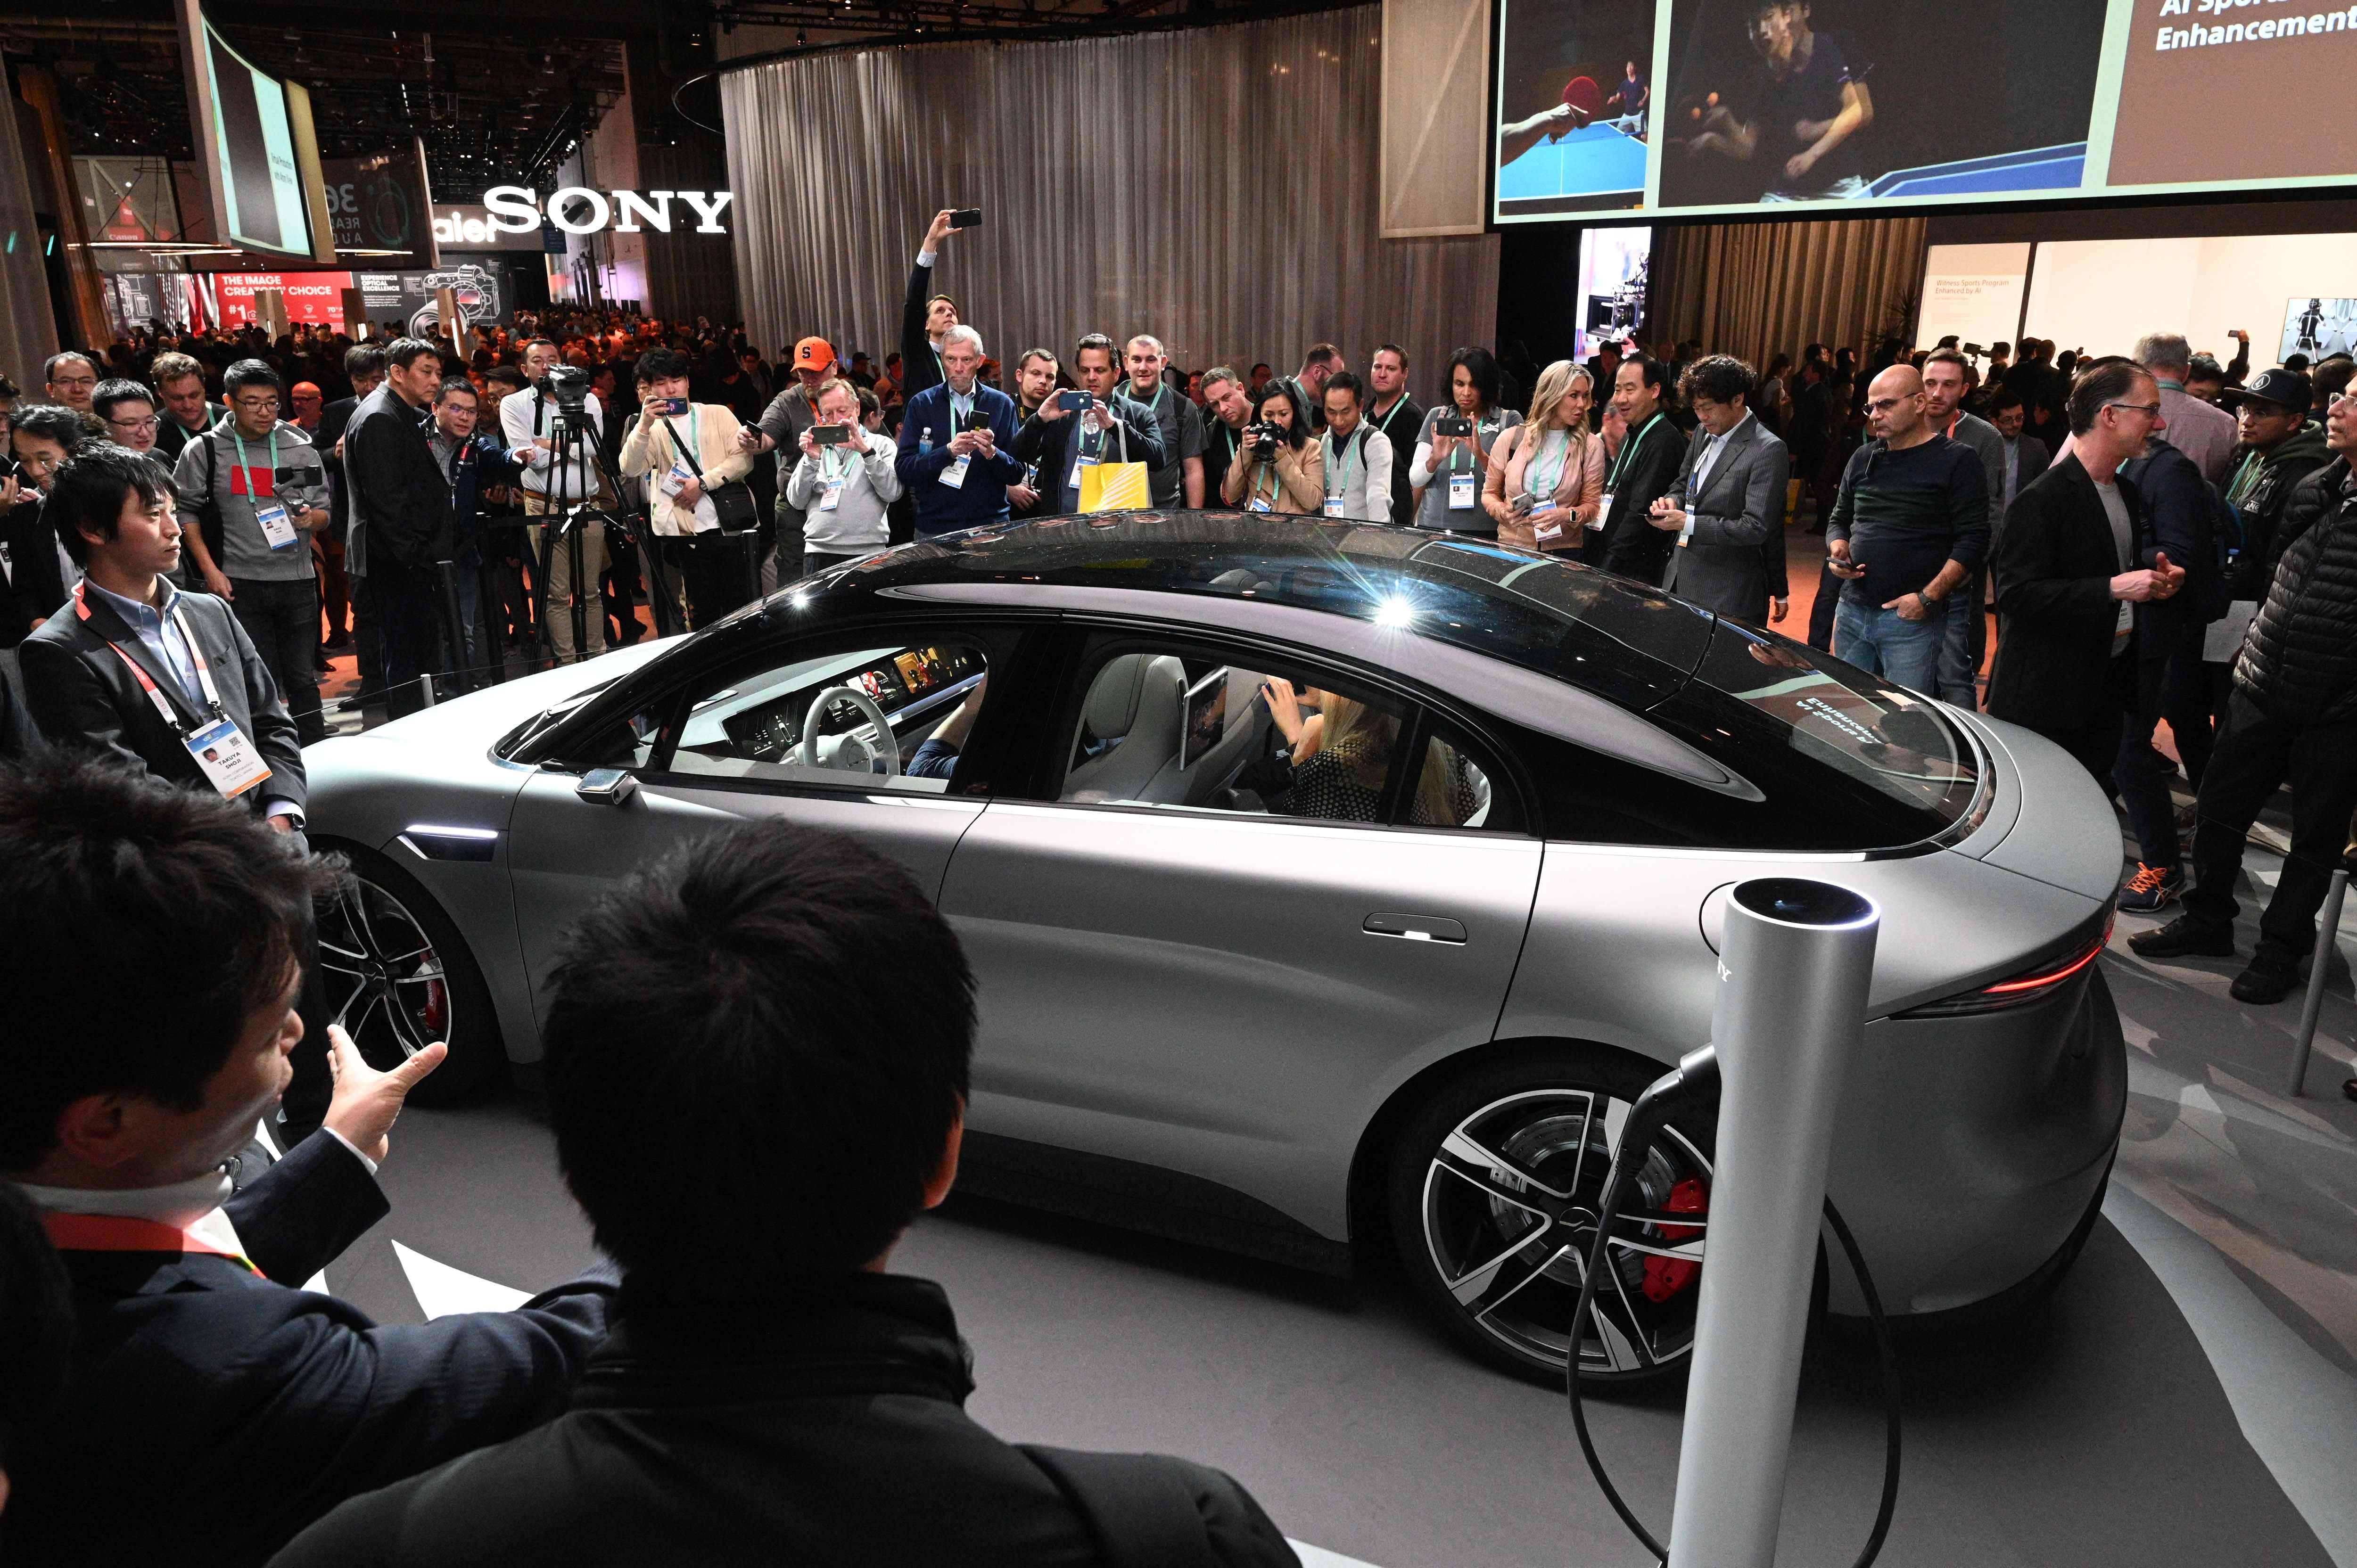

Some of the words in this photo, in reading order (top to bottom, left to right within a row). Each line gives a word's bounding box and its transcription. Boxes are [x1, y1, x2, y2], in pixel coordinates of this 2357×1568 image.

[2156, 5, 2357, 50] Enhancement
[484, 186, 734, 234] SONY
[222, 276, 243, 285] THE
[245, 275, 281, 285] IMAGE
[1982, 279, 2009, 287] Program
[288, 286, 332, 295] CHOICE
[229, 304, 247, 320] #1
[802, 346, 811, 359] S
[218, 752, 241, 765] TAKUYA
[225, 759, 241, 769] SHOJI
